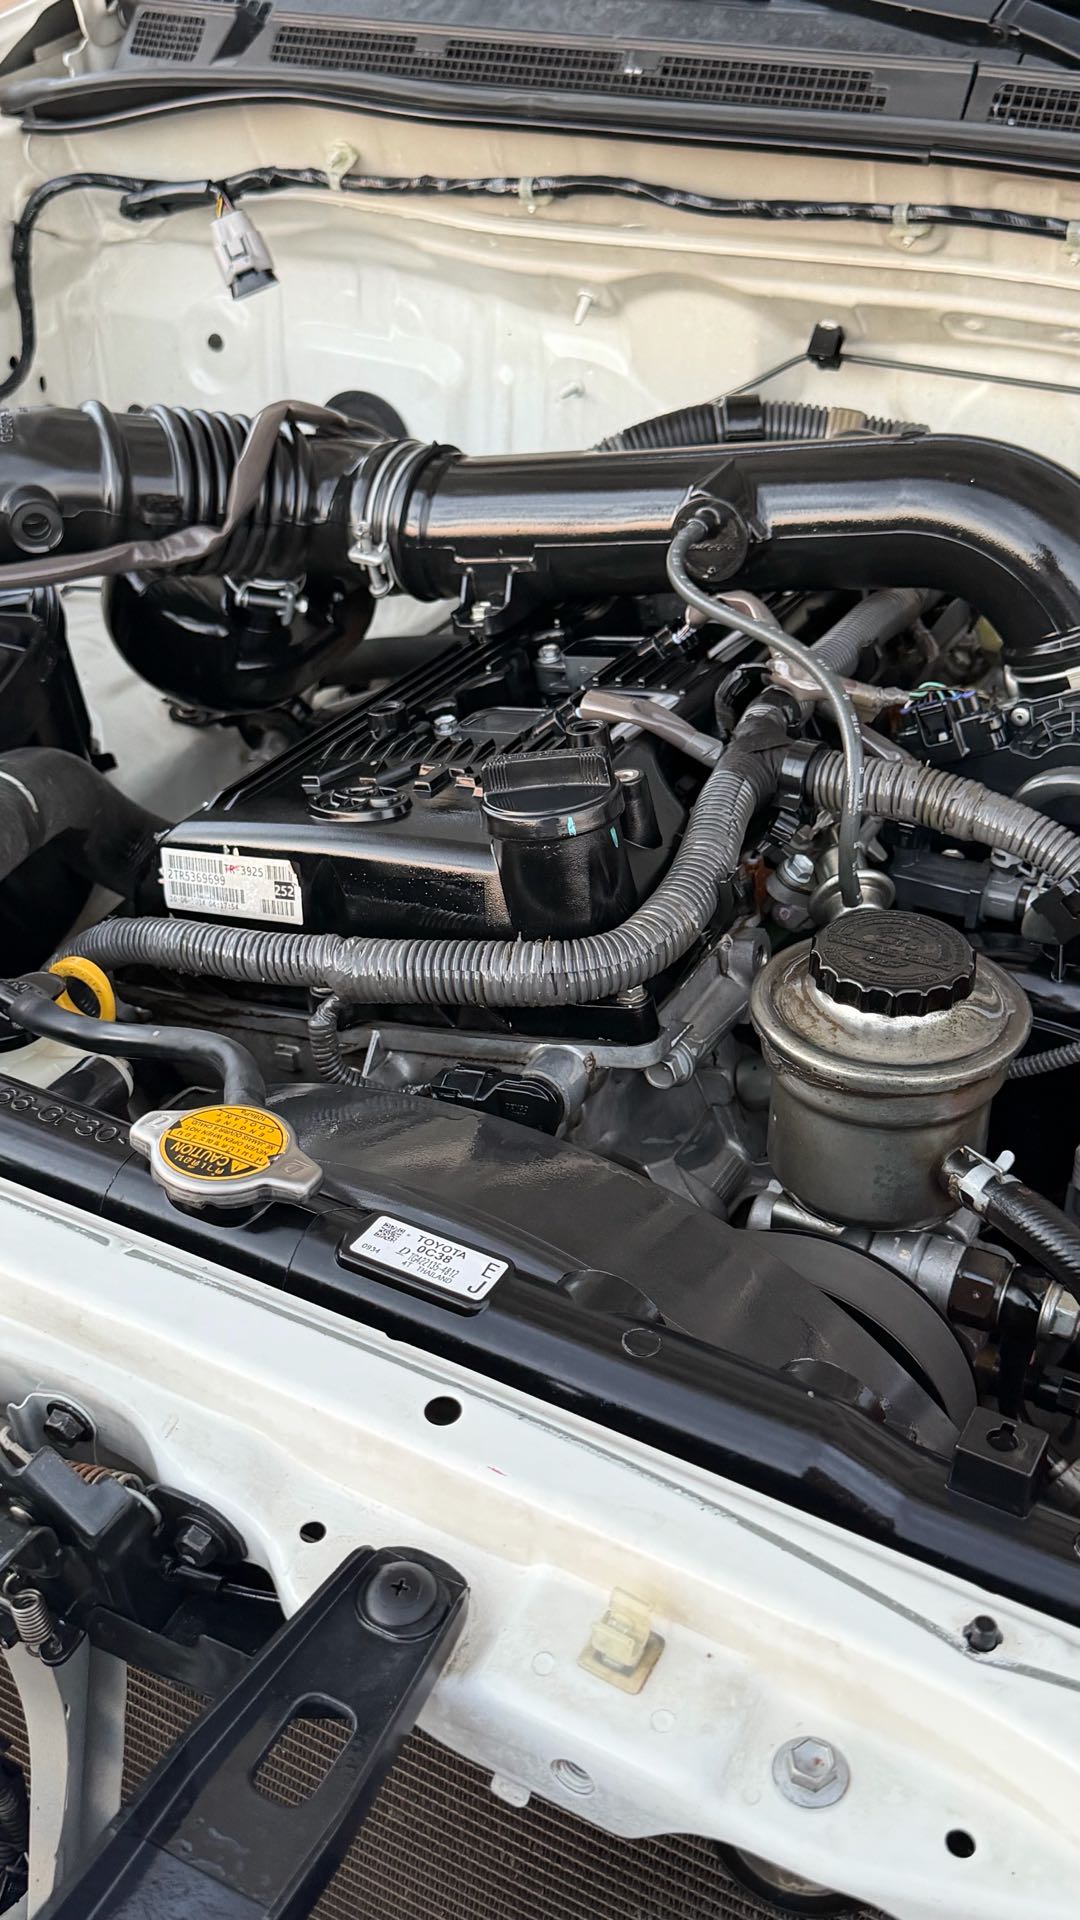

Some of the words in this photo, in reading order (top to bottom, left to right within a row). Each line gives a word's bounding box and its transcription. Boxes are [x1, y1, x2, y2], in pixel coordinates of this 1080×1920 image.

[168, 868, 226, 886] 2TR5369699
[274, 883, 294, 898] 252
[201, 1129, 223, 1141] WHEN
[215, 1118, 266, 1139] ENGINE
[223, 1136, 244, 1148] OPEN
[244, 1143, 269, 1157] NEVER
[169, 1141, 230, 1167] CAUTION
[361, 1243, 381, 1255] 0934
[417, 1234, 466, 1260] TOYOTA
[416, 1266, 453, 1284] THAILAND
